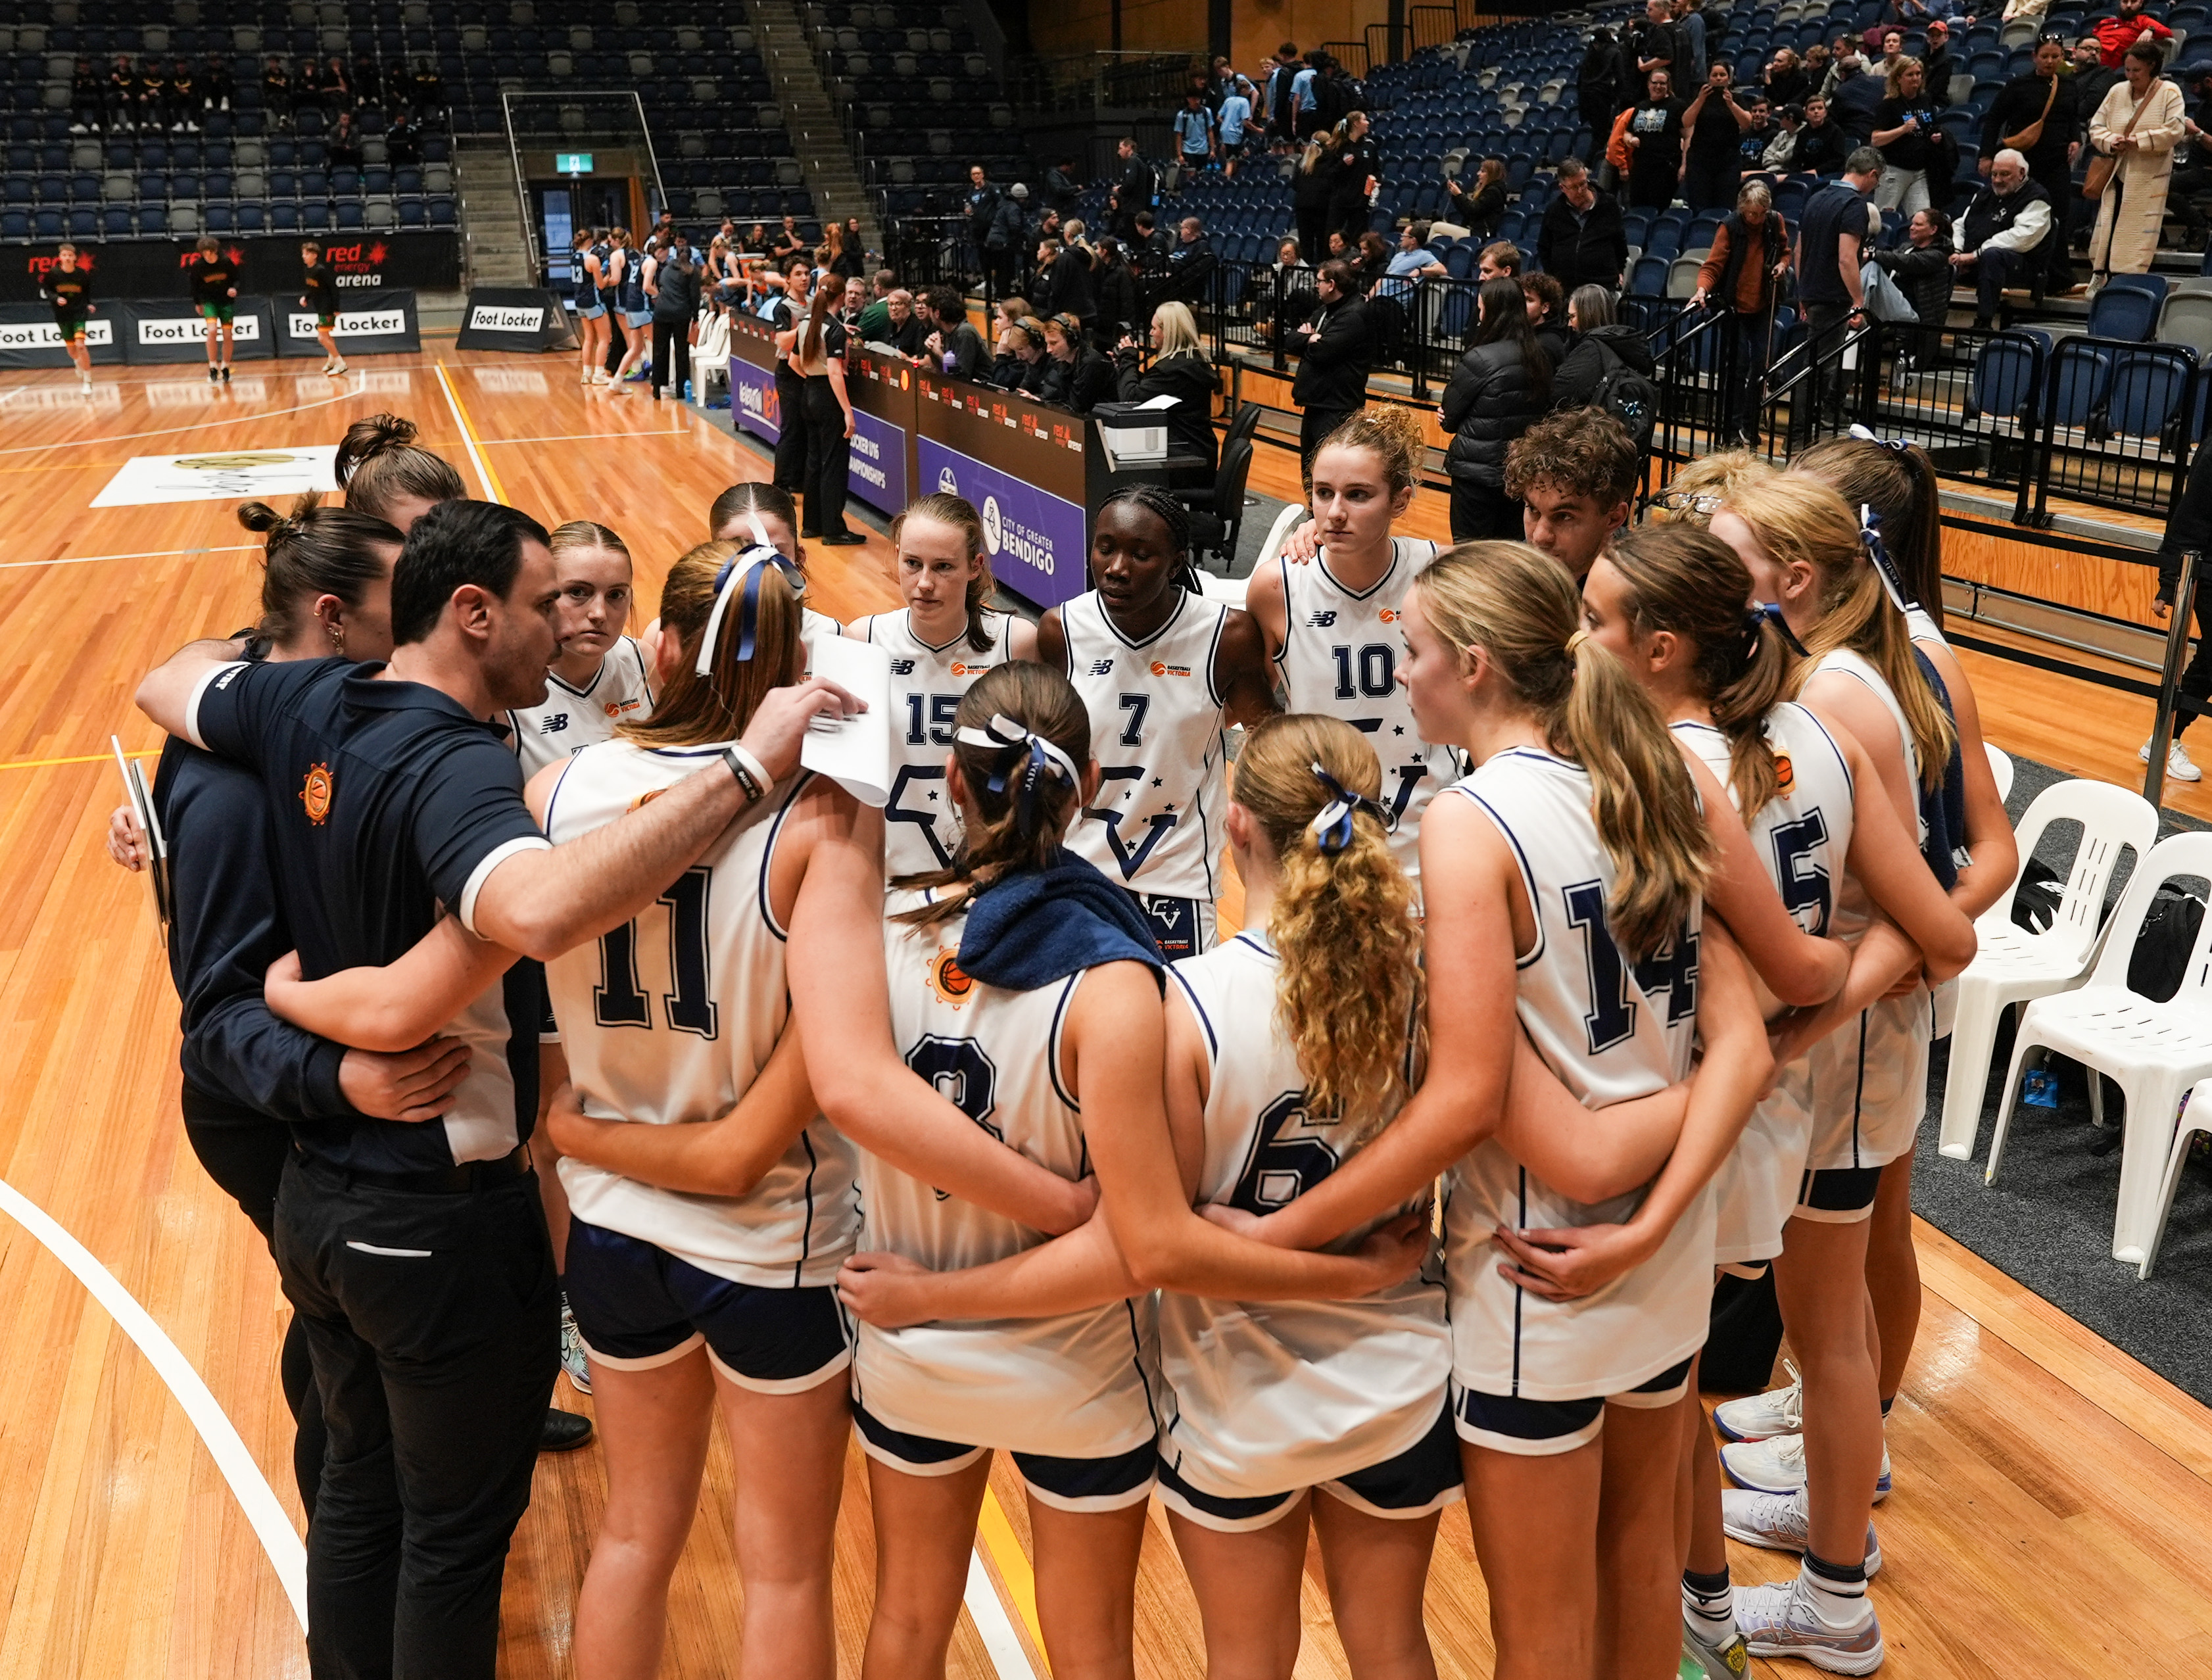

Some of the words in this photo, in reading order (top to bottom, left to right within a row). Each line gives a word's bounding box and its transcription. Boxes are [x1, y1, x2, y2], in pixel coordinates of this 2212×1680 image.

[325, 243, 362, 262] red
[335, 274, 381, 287] arena
[0, 329, 35, 343] oot
[43, 328, 105, 342] Loer
[145, 325, 184, 338] Foot
[192, 324, 253, 336] Loer
[340, 317, 399, 331] Locker
[475, 310, 498, 326] Foot
[501, 311, 539, 327] Locker
[1001, 516, 1015, 532] CITY
[1016, 523, 1025, 537] OF
[1026, 529, 1053, 552] GREATER
[1002, 529, 1055, 575] BENDIGO
[1332, 643, 1396, 700] 10
[620, 703, 640, 713] VICTORIA
[906, 692, 965, 746] 15
[1118, 692, 1150, 747] 7
[738, 770, 753, 789] zone
[1770, 806, 1831, 938] 5
[593, 865, 719, 1041] 11
[1561, 878, 1700, 1055] 14
[1227, 1090, 1345, 1216] 6
